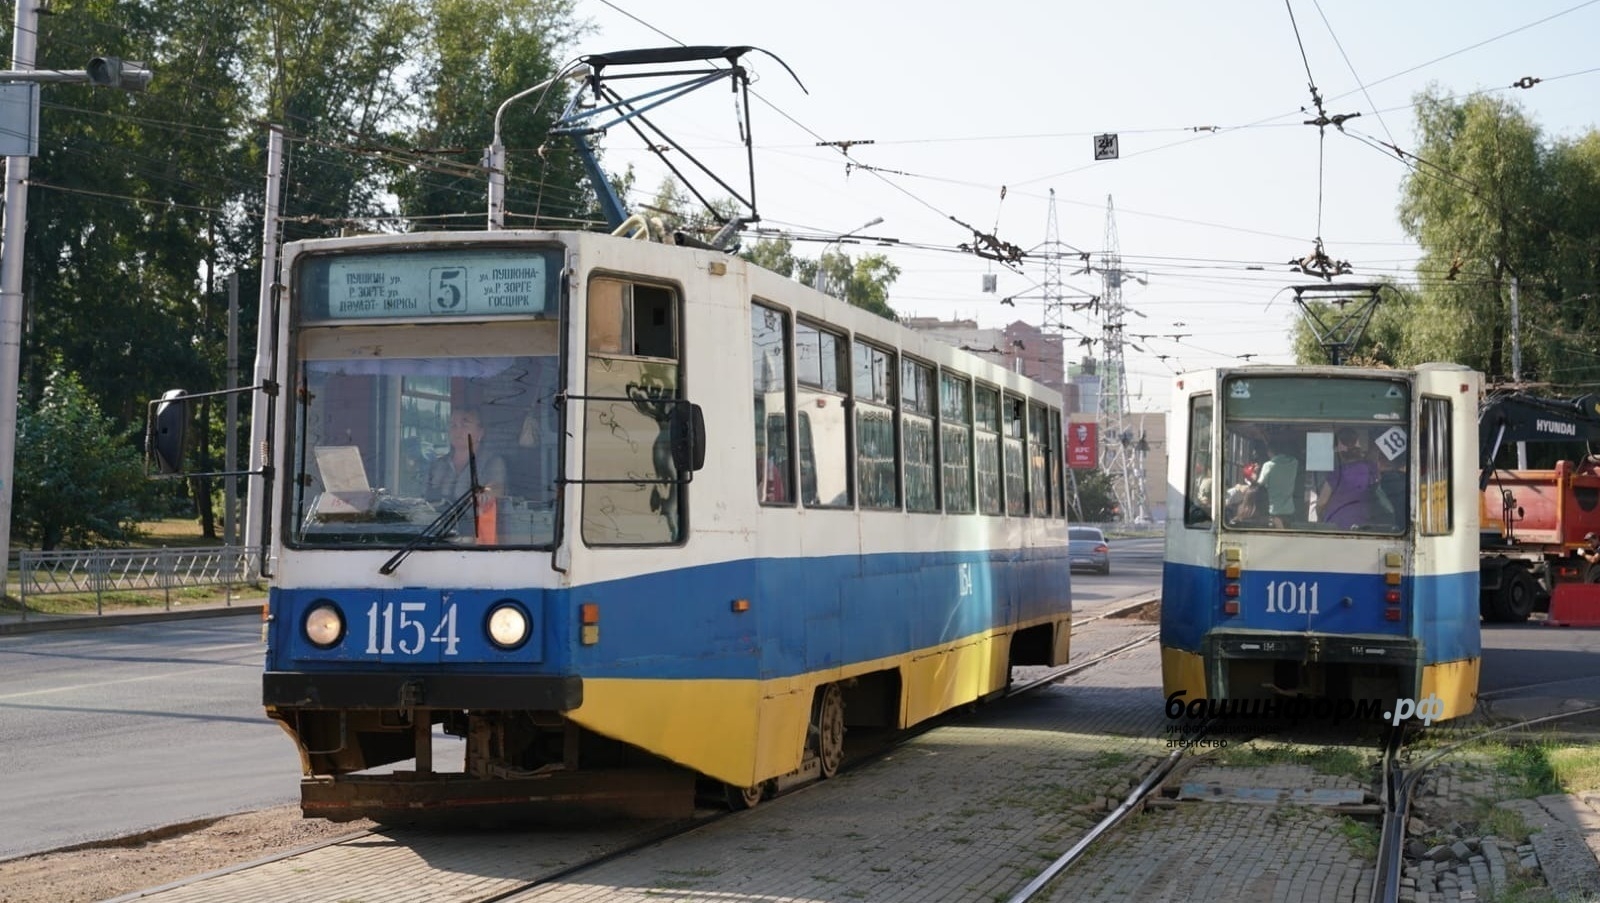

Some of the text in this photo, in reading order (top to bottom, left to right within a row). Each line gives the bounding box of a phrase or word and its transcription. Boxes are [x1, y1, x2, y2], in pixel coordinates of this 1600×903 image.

[346, 273, 385, 284] ПУШКИН
[503, 281, 532, 293] ЗОРГЕ
[358, 286, 385, 297] ЗОРГЕ
[437, 270, 460, 309] 5
[488, 295, 529, 307] ГОСЦИРК
[1536, 419, 1576, 436] HYUNDAI
[1383, 431, 1405, 454] 18
[1265, 580, 1320, 614] 1011
[365, 602, 461, 655] 1154
